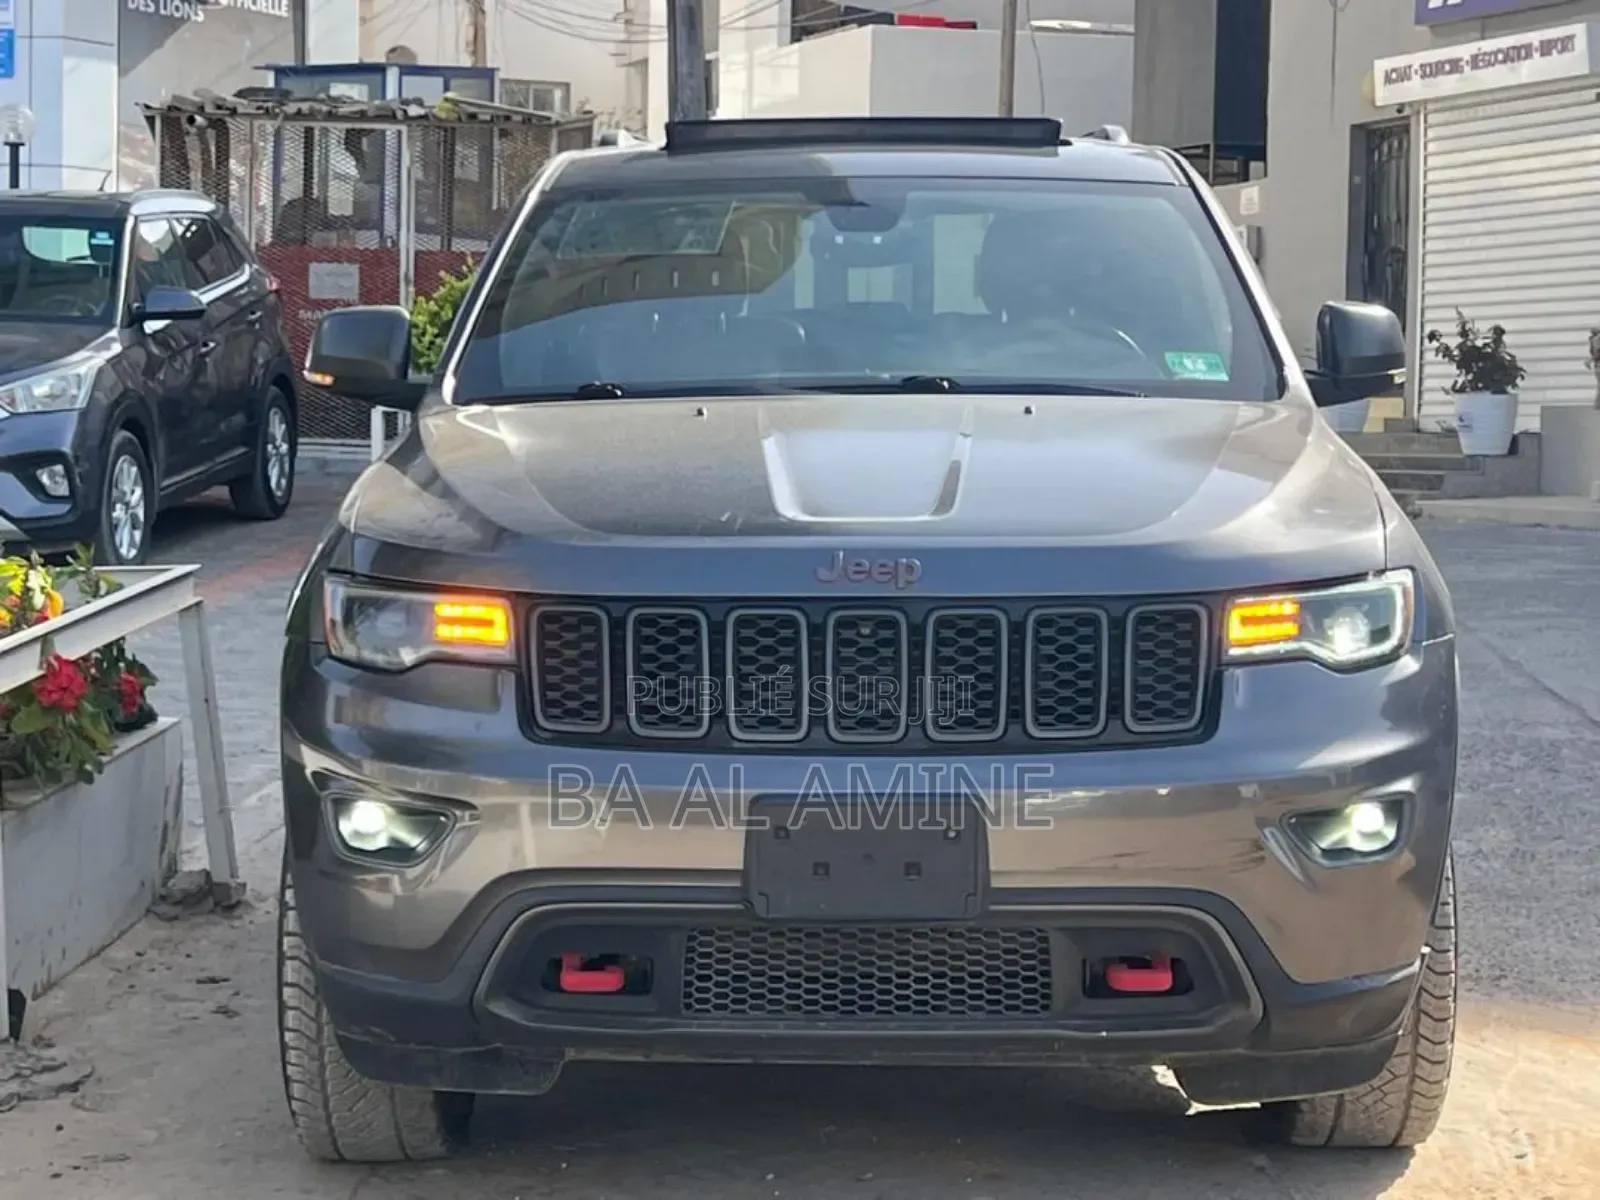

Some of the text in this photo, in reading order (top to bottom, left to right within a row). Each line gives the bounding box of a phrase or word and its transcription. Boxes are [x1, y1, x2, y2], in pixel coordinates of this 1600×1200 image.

[127, 0, 204, 22] DES LIONS
[1384, 64, 1413, 86] ACHAT
[814, 550, 922, 589] Jeep
